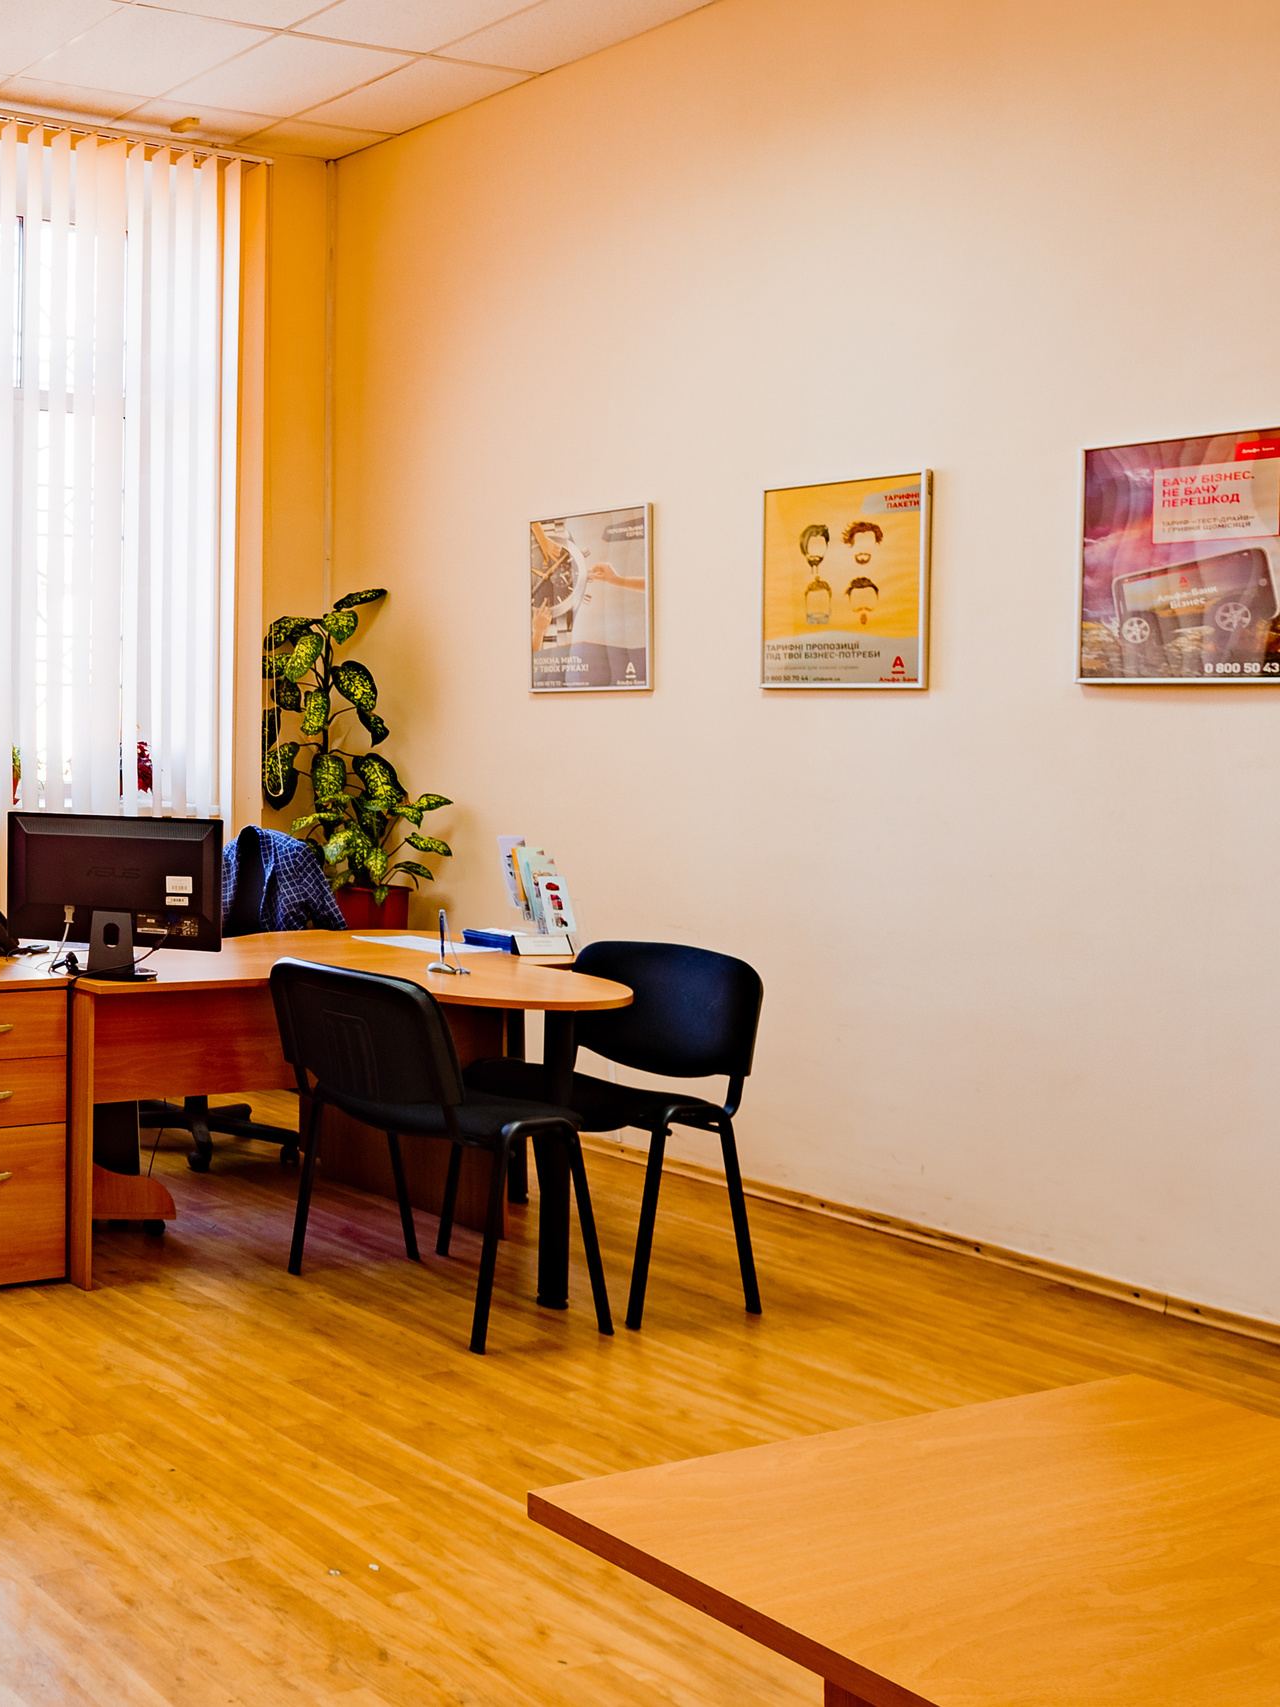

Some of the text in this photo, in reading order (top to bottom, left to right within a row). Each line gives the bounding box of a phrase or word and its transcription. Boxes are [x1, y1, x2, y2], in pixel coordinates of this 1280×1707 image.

[1162, 475, 1197, 487] БАЧУ
[1162, 484, 1219, 498] НЕ БАЧУ
[884, 492, 920, 502] ТАРИФНІ
[1162, 493, 1240, 508] ПЕРЕШКОД
[887, 500, 920, 509] ПАКЕТИ
[1203, 521, 1251, 530] ЩОМІСЯЦЯ
[1157, 586, 1217, 602] Альфа-Банк
[1170, 597, 1206, 609] Бізнес
[767, 643, 860, 652] ТАРИФНІ ПРОПОЗИЦІЇ
[561, 656, 582, 664] МИТЬ
[766, 652, 781, 660] ПІД
[804, 650, 880, 659] БІЗНЕС-ПОТРЕБИ
[540, 664, 560, 673] ТВОЇХ
[562, 664, 589, 672] РУКАХ!
[1204, 662, 1280, 673] 0 800 50 43
[86, 866, 140, 879] ASUS
